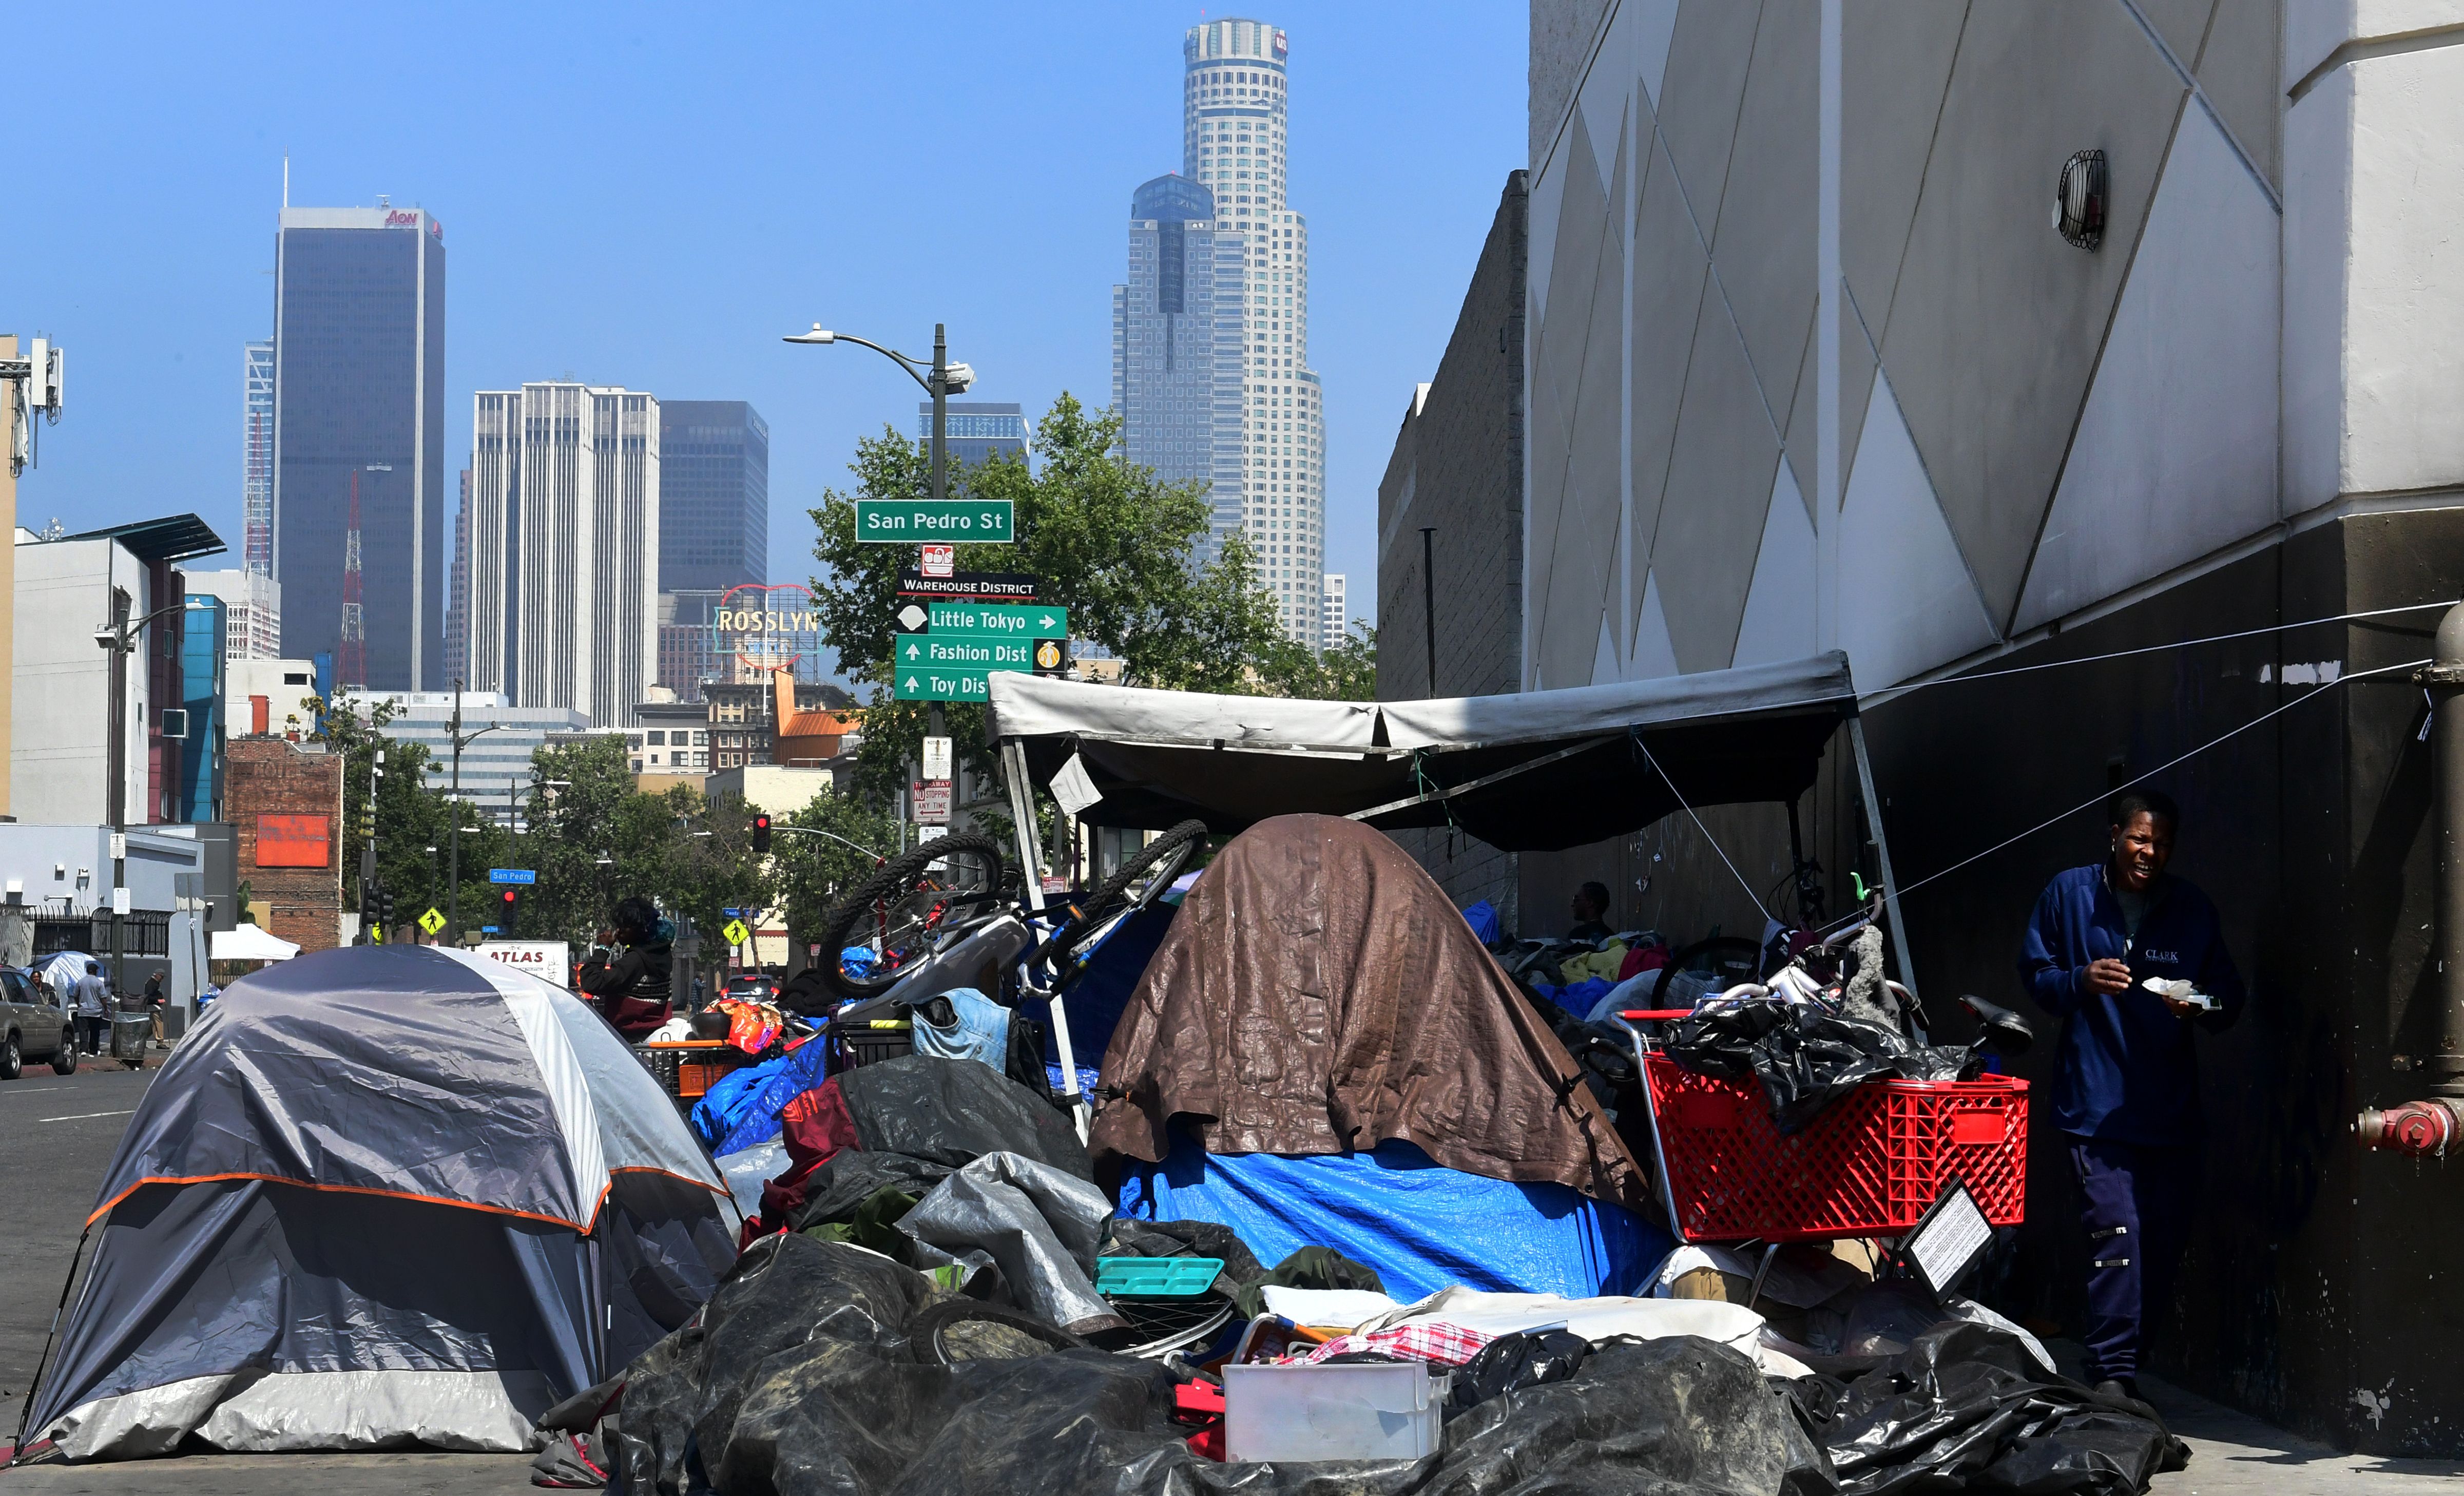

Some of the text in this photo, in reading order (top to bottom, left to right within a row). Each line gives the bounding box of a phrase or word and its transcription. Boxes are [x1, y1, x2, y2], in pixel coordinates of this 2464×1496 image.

[868, 513, 1003, 529] San Pedro St
[904, 579, 1034, 594] WAREHOUSE DISTRICT
[719, 610, 818, 632] ROSSLYN
[931, 610, 1026, 632] Little Tokyo
[930, 643, 1027, 662] Fashion Dist
[930, 676, 988, 696] Toy Dis
[914, 789, 925, 800] NO
[490, 951, 543, 963] ATLAS
[2146, 949, 2178, 960] CLARK
